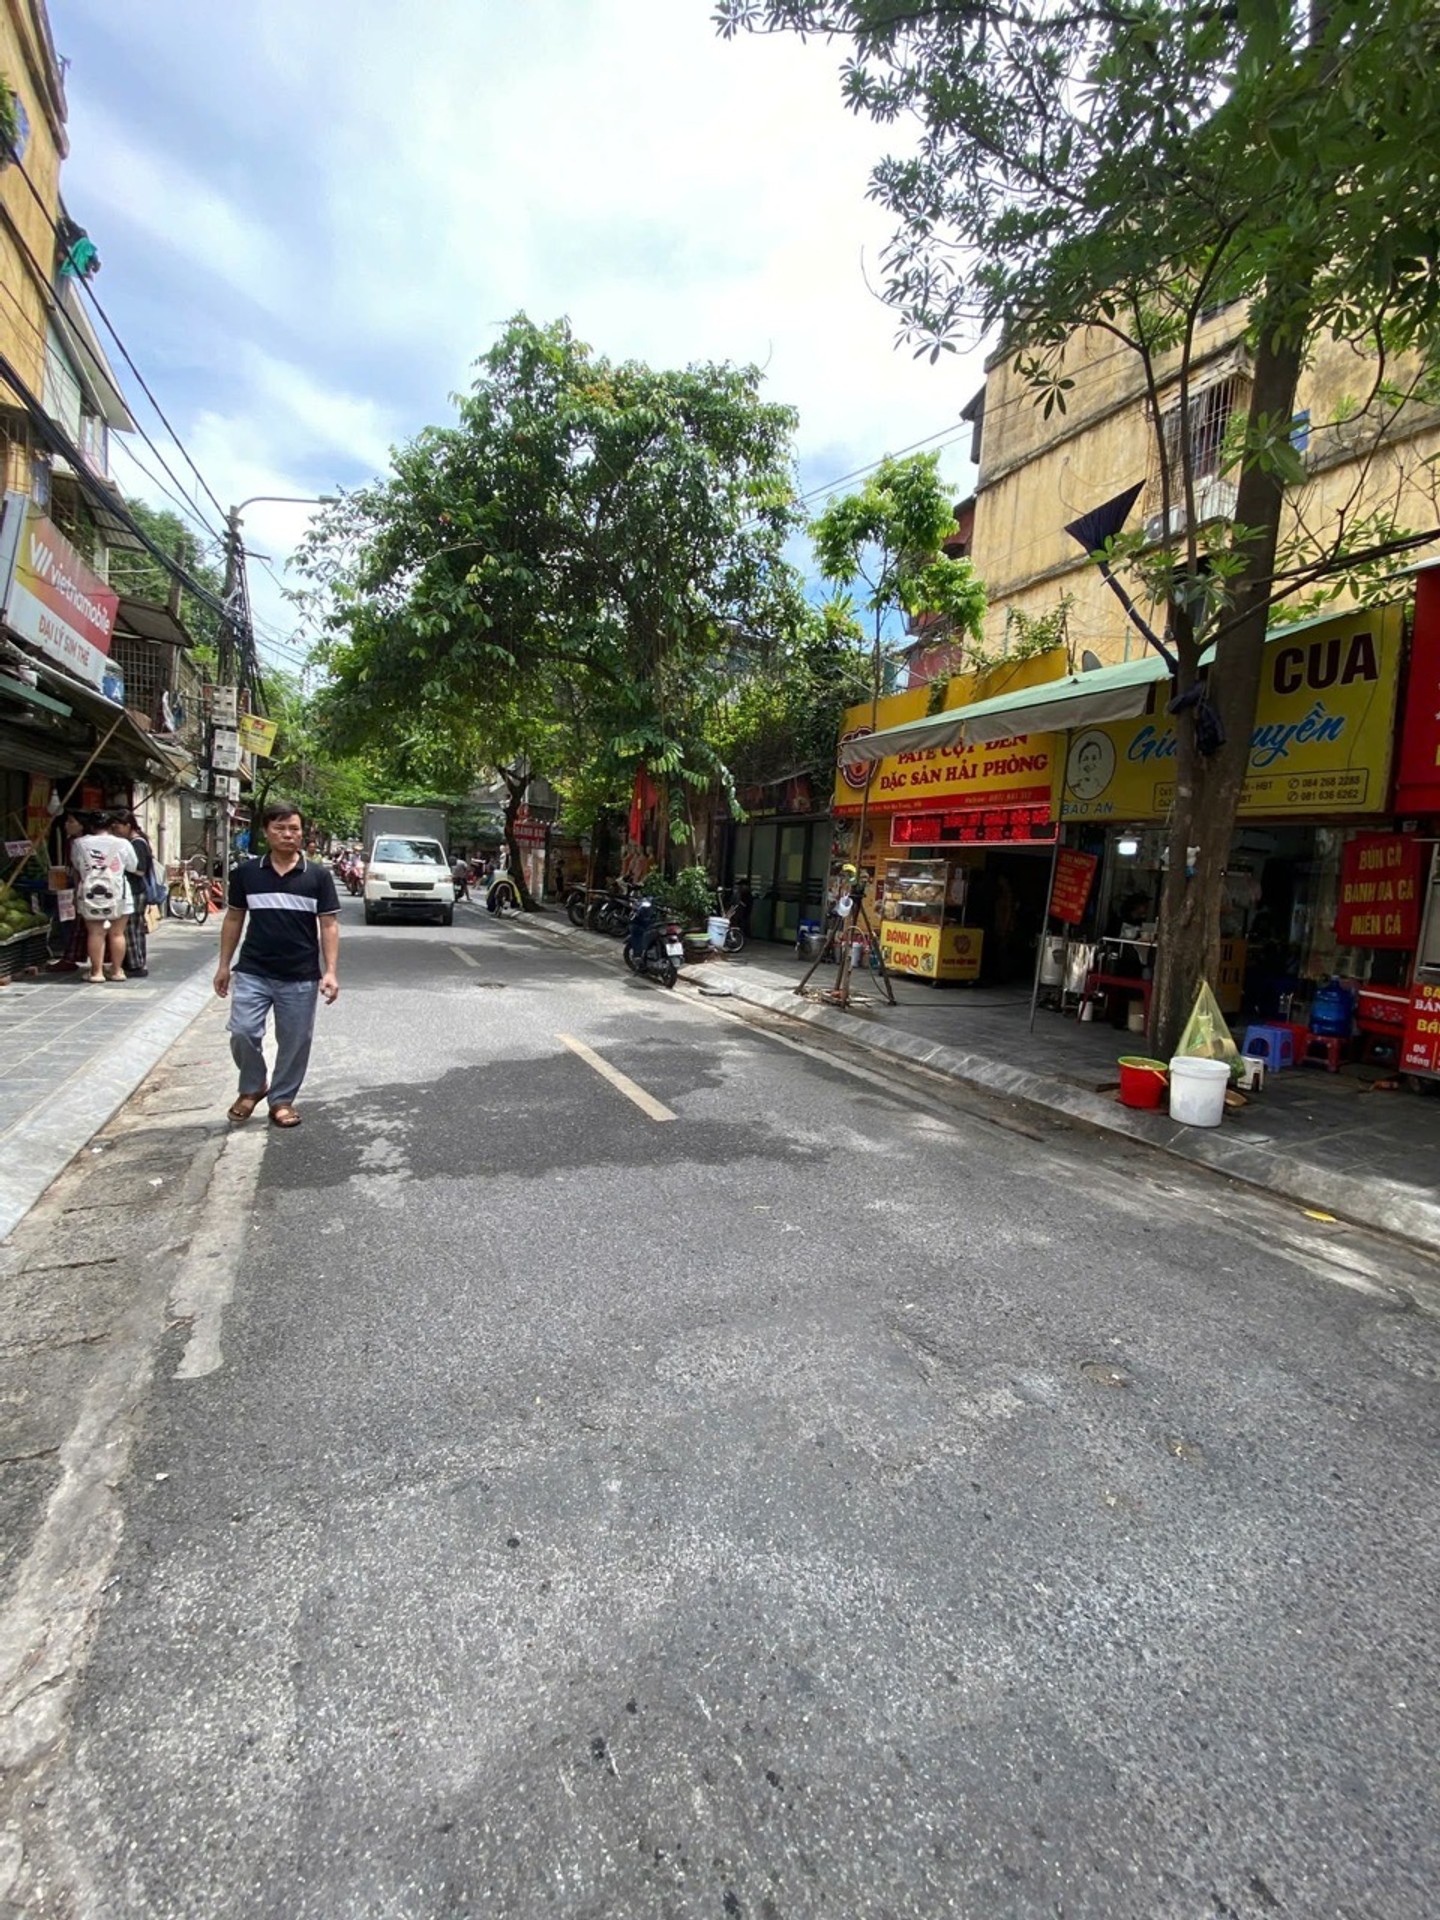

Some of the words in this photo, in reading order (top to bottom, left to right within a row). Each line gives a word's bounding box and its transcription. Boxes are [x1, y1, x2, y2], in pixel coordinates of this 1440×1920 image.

[51, 562, 111, 635] vietnamobile
[1273, 632, 1378, 695] CUA
[910, 765, 942, 786] SẢN
[945, 759, 978, 782] HẢI
[982, 753, 1049, 777] PHÒNG
